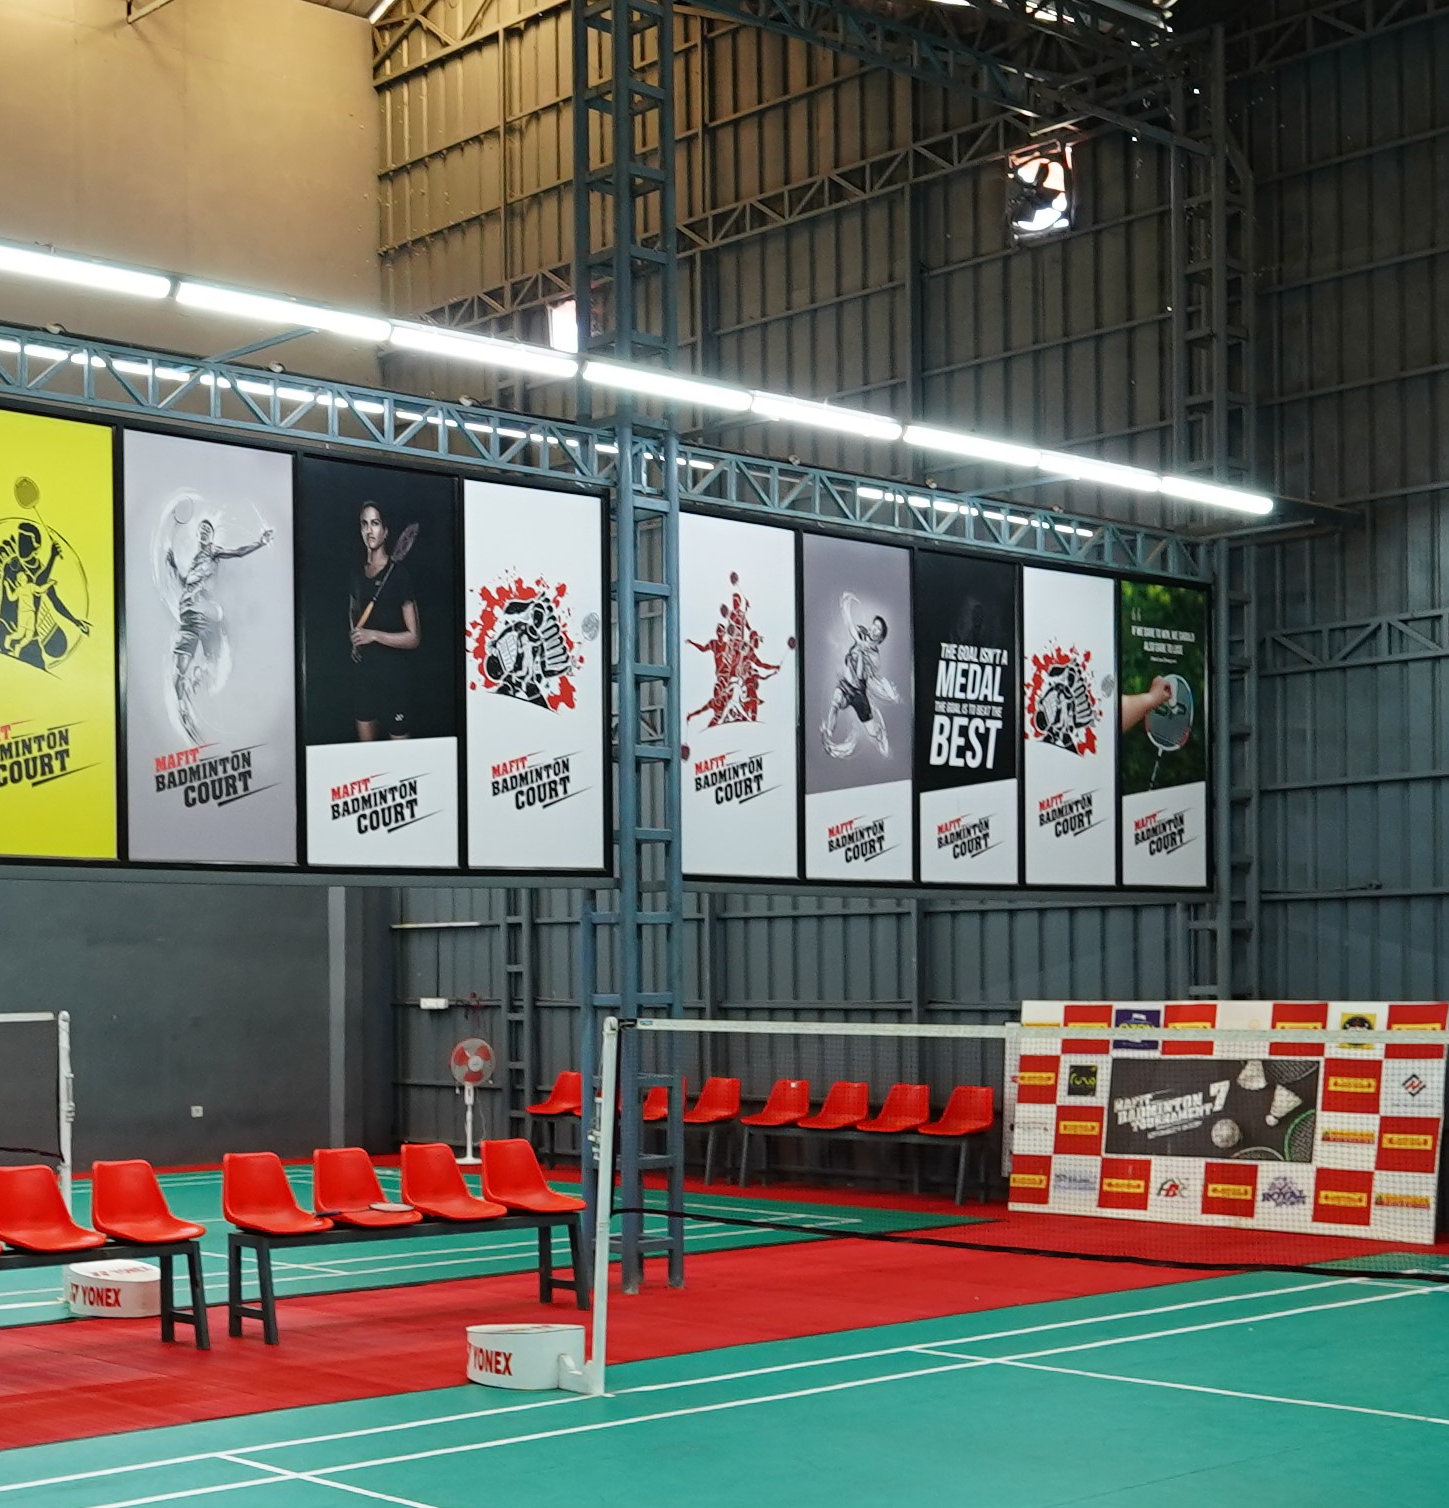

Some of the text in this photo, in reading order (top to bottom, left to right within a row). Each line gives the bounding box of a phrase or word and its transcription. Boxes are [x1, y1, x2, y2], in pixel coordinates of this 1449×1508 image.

[941, 642, 957, 660] THE
[958, 644, 979, 662] GOAL
[1001, 649, 1008, 666] A
[935, 659, 1004, 703] MEDAL
[929, 714, 1003, 769] BEST
[155, 748, 199, 773] MAFIT
[155, 751, 251, 792] BADMINTON
[492, 756, 527, 779] MAFIT
[695, 754, 726, 775] MAFIT
[695, 757, 763, 792] BADMINTON
[184, 770, 252, 808] COURT
[331, 778, 370, 801] MAFIT
[492, 758, 570, 797] BADMINTON
[515, 775, 571, 810] COURT
[715, 773, 764, 805] COURT
[331, 780, 418, 820] BADMINTON
[1039, 793, 1063, 811] MAFIT
[1039, 794, 1092, 827] BADMINTON
[357, 798, 418, 834] COURT
[828, 820, 854, 838] MAFIT
[937, 818, 961, 835] MAFIT
[1054, 809, 1093, 838] COURT
[1134, 812, 1157, 831] MAFIT
[1134, 813, 1184, 846] BADMINTON
[828, 820, 885, 852] BADMINTON
[937, 818, 990, 849] BADMINTON
[952, 833, 990, 859] COURT
[1149, 828, 1185, 856] COURT
[845, 835, 885, 863] COURT
[1209, 1080, 1230, 1112] 7
[81, 1285, 121, 1308] YONEX
[474, 1347, 513, 1376] YONEX
